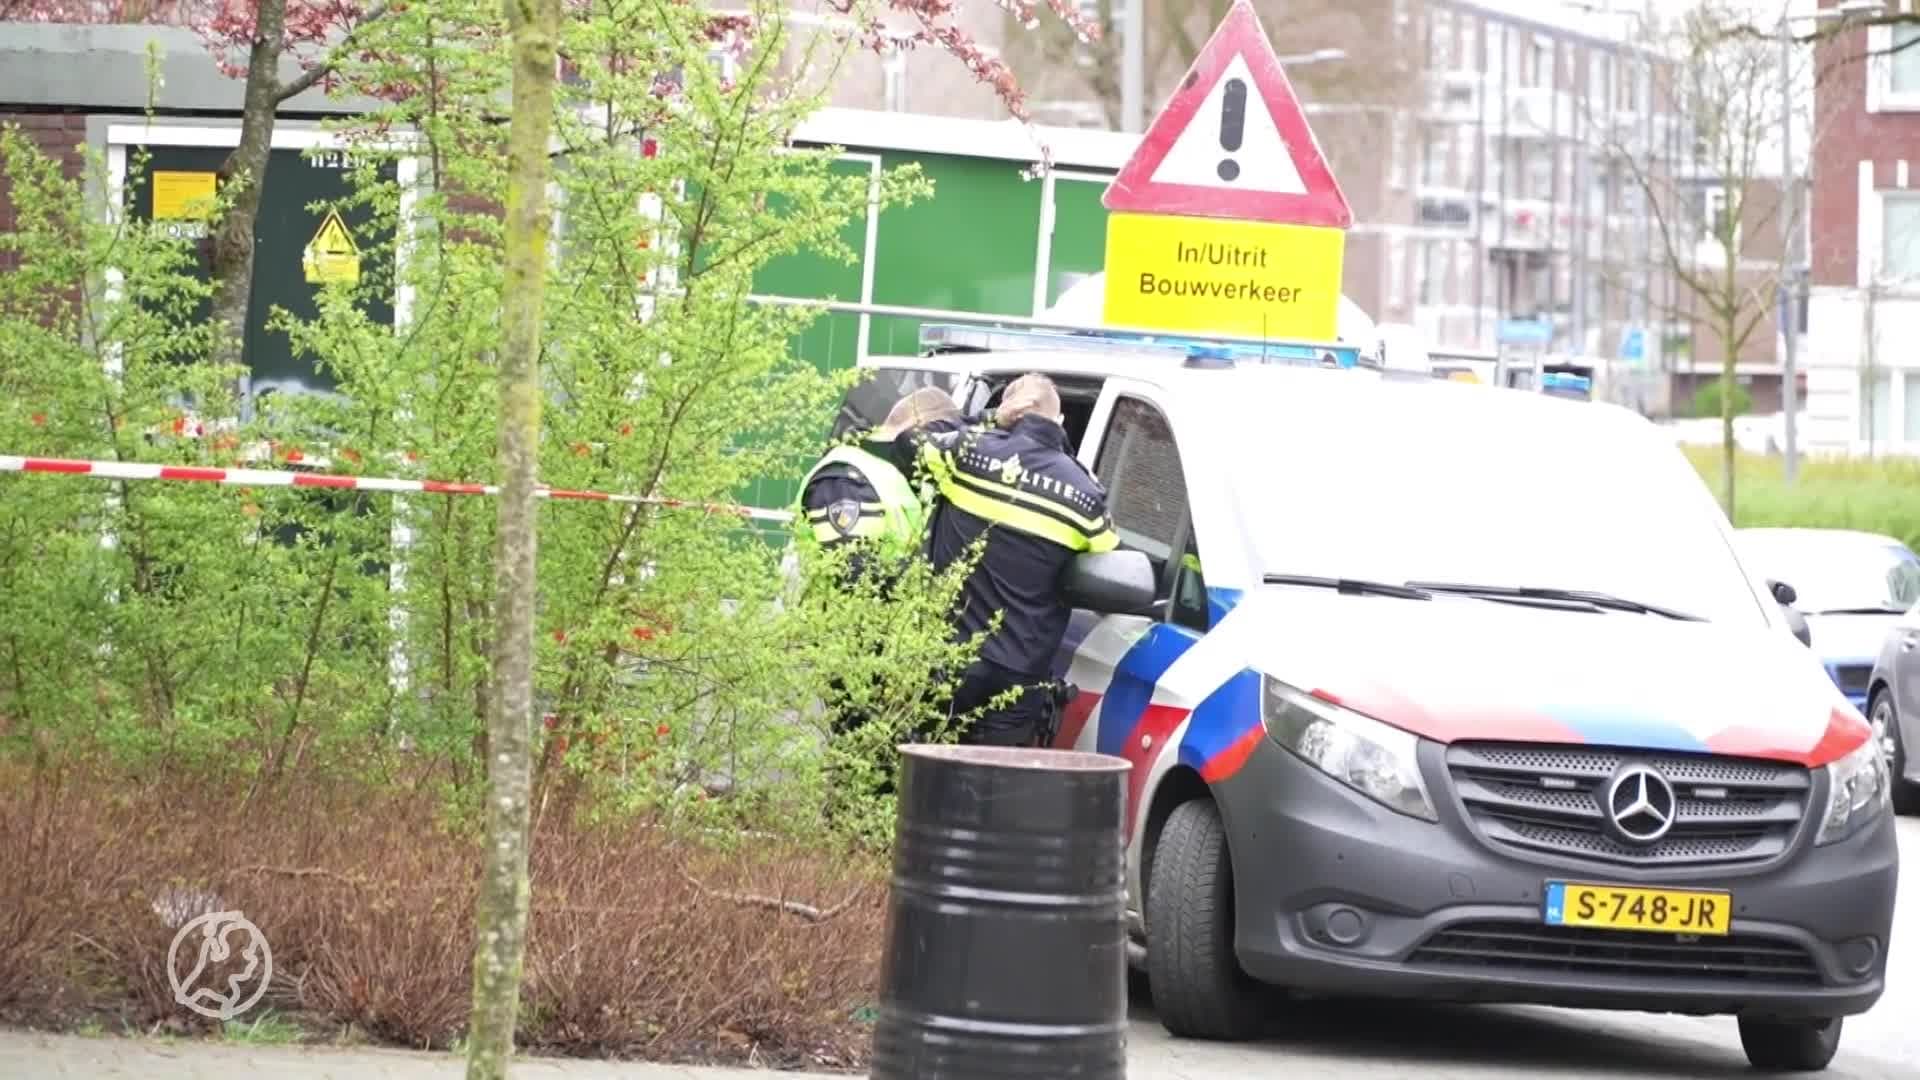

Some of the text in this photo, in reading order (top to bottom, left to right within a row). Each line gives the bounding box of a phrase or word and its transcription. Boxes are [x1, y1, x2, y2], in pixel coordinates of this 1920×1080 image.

[1177, 240, 1268, 268] In/Uitrit
[1139, 272, 1302, 303] Bouwverkeer
[1576, 890, 1716, 928] S-748-JR
